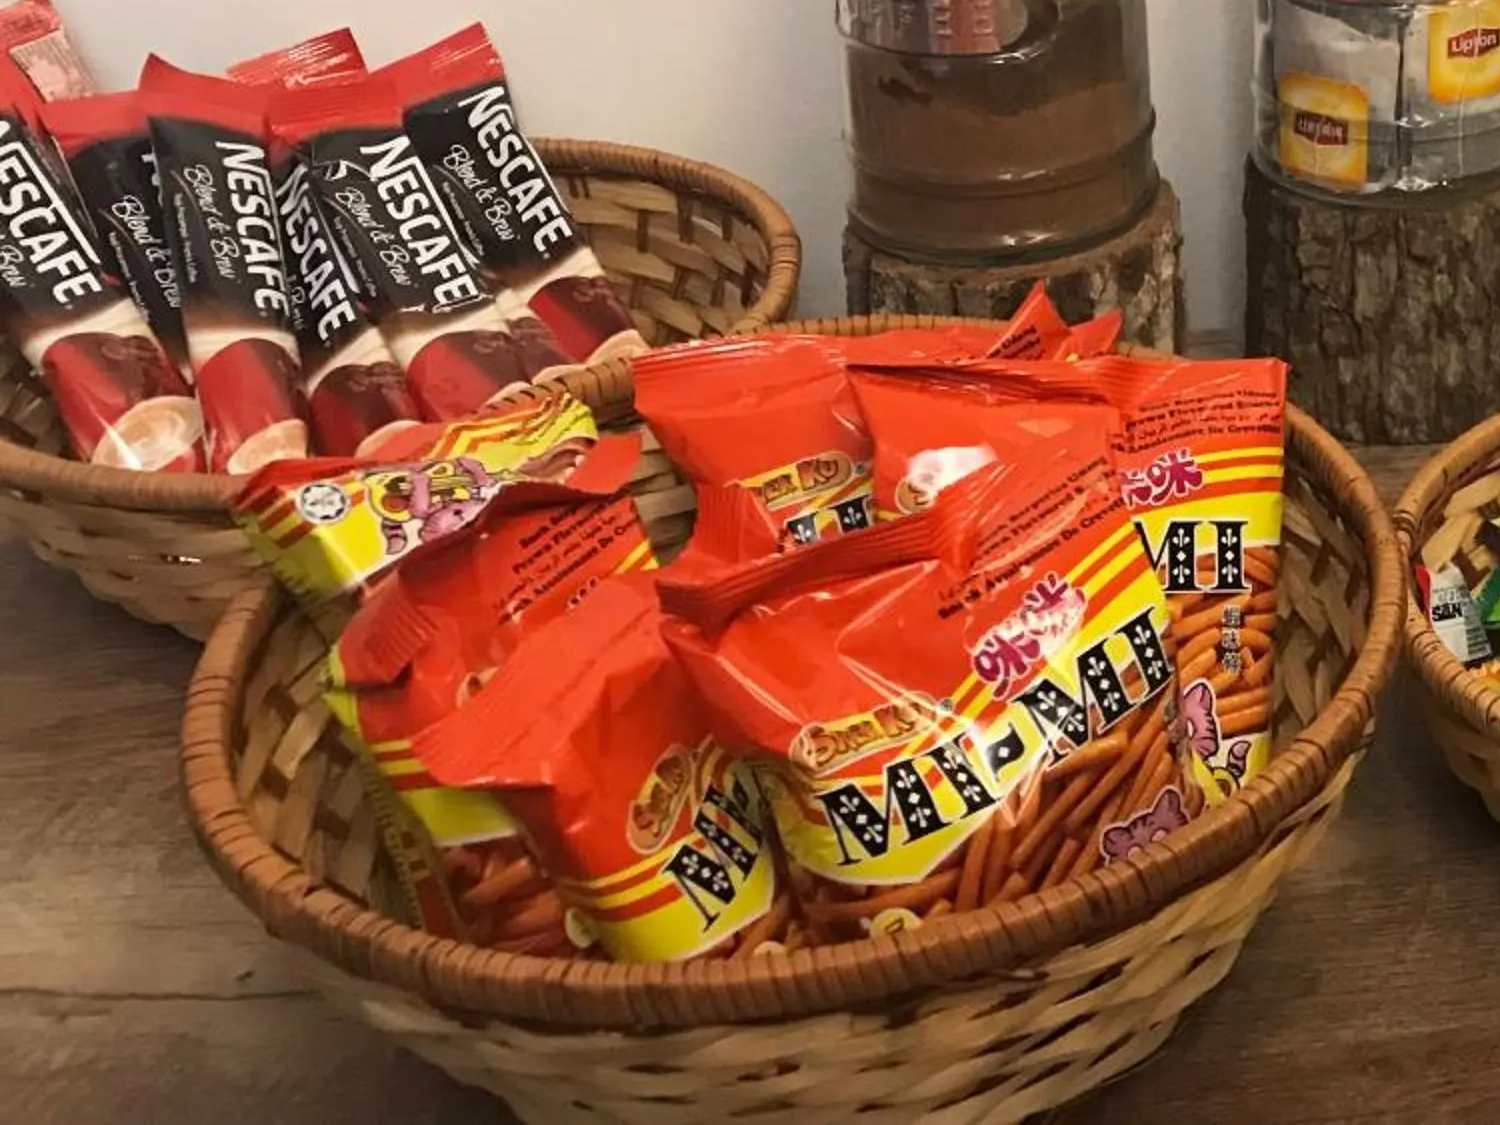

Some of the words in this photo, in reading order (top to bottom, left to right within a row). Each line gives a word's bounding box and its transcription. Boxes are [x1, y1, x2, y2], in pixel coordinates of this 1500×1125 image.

[112, 194, 163, 244] Blend
[183, 164, 224, 222] Blend
[211, 235, 241, 280] Brew
[335, 186, 385, 232] Blend
[379, 246, 412, 287] Brew
[443, 143, 487, 191] Blend
[485, 198, 515, 241] Brew
